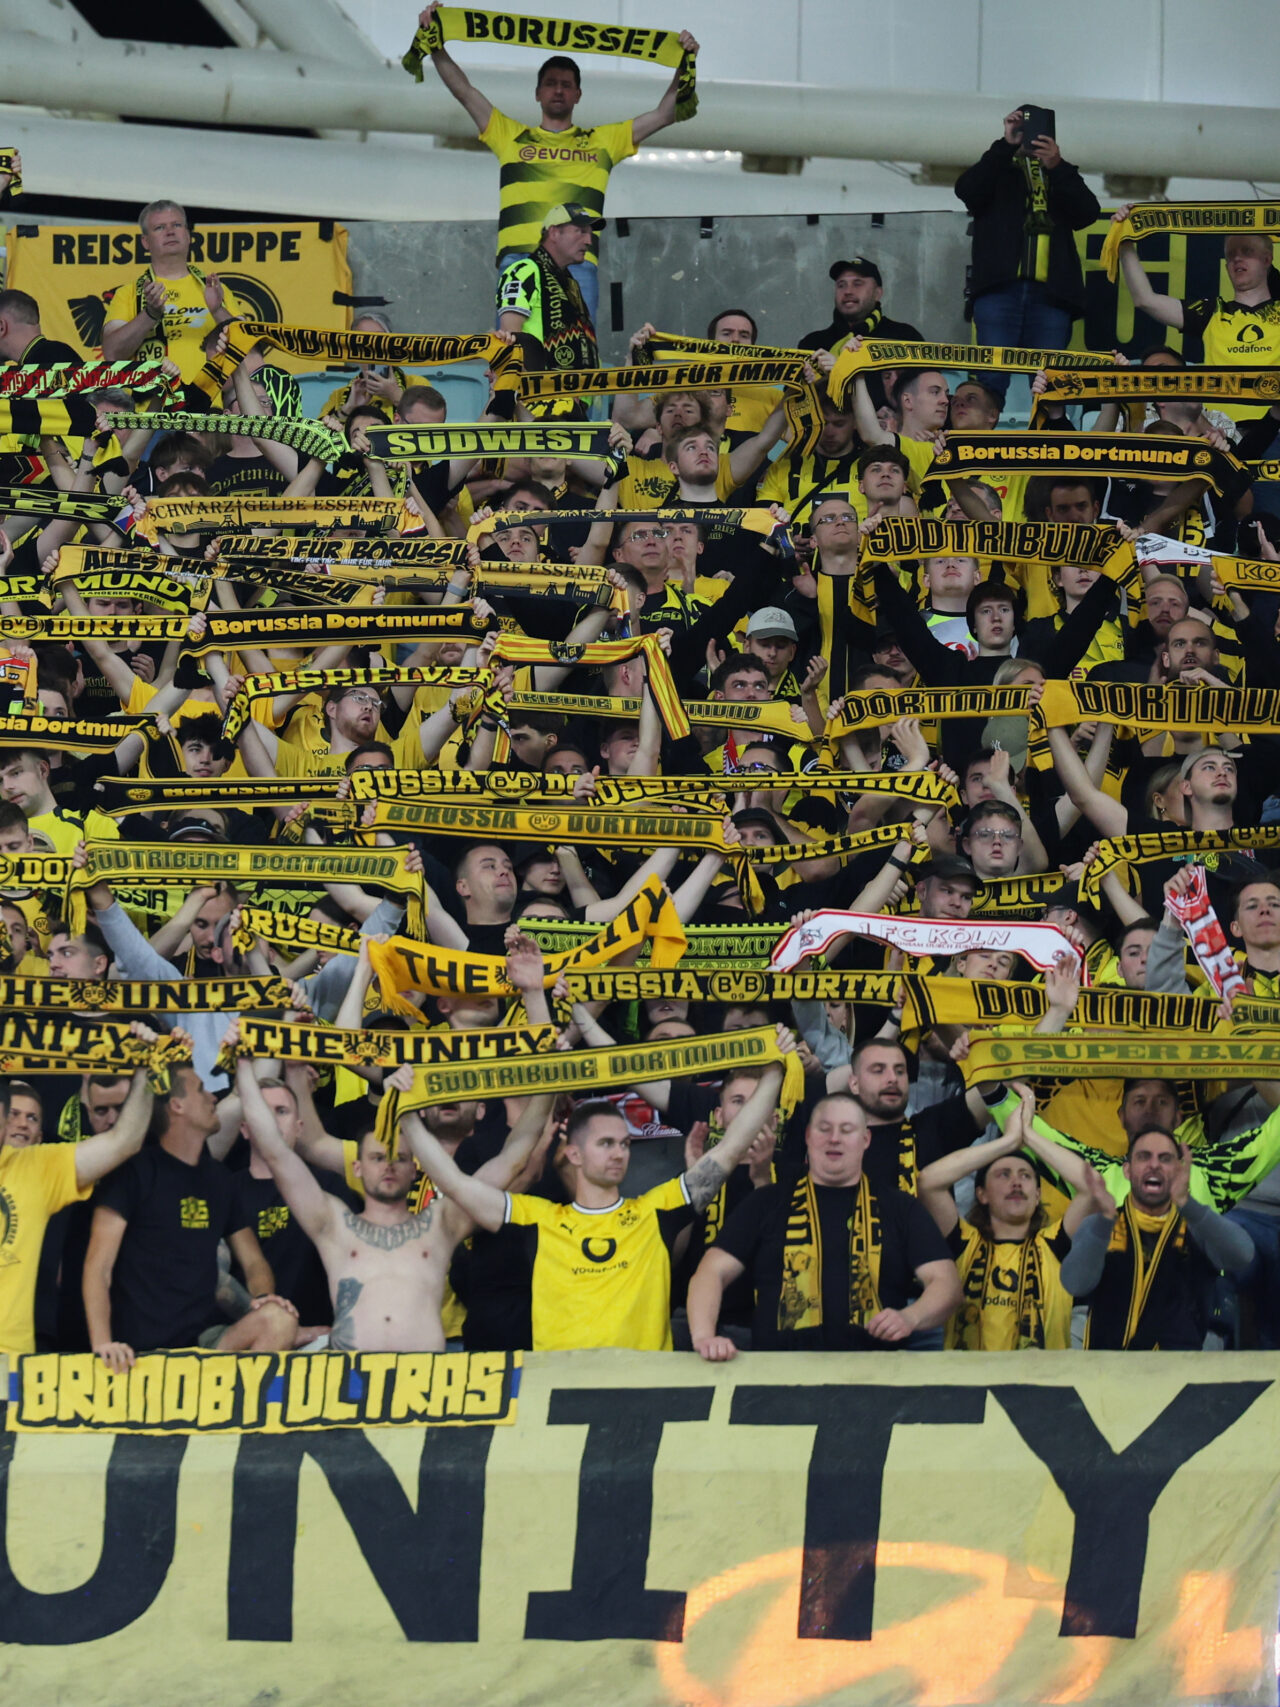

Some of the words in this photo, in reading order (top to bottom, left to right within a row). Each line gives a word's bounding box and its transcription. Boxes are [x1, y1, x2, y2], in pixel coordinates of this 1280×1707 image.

[463, 11, 668, 59] BORUSSE!
[538, 147, 599, 164] EVONIK
[1130, 208, 1256, 233] SÜDTRIBÜNE
[52, 230, 302, 266] REISERUPPE
[866, 342, 994, 365] SÜDTRIBÜNE
[1226, 343, 1273, 354] vodafone
[551, 365, 607, 392] 1974
[616, 367, 664, 389] UND
[672, 360, 723, 387] FÜR
[1095, 372, 1242, 395] FRECHEN
[386, 428, 598, 458] SÜDWEST
[957, 444, 1060, 462] Borussia
[1063, 445, 1189, 466] Dortmund
[312, 500, 398, 515] ESSENER
[218, 536, 286, 560] ALLES
[291, 537, 343, 562] FÜR
[870, 517, 1121, 567] SÜDTRIBÜNE
[82, 551, 158, 572] ALLES
[530, 562, 609, 585] ESSENE
[50, 616, 190, 638] DORTMU
[210, 614, 323, 636] Borussia
[326, 611, 465, 632] Dortmund
[245, 665, 494, 699] LLSPIELVER
[840, 687, 1030, 727] DORTMU
[1070, 680, 1280, 726] DORTMU
[351, 769, 483, 800] RUSSIA
[386, 804, 518, 830] BORUSSIA
[567, 813, 714, 838] DORTMUND
[762, 825, 912, 864] DORTMU
[87, 847, 240, 875] SÜDTRIBÜNE
[249, 852, 399, 879] DORTMUND
[248, 908, 361, 950] RUSSI
[928, 921, 1012, 947] KÖLN
[396, 949, 490, 994] THE
[569, 969, 703, 1001] RUSSIA
[719, 971, 759, 993] BVB
[121, 976, 284, 1012] UNITY
[972, 980, 1222, 1034] DOTMU
[246, 1022, 346, 1061] THE
[391, 1027, 554, 1065] UNITY
[1022, 1042, 1177, 1062] SUPER
[425, 1056, 599, 1097] SÜDTRIBÜNE
[609, 1036, 766, 1078] DORTMUND
[284, 1350, 507, 1424] ULTRAS
